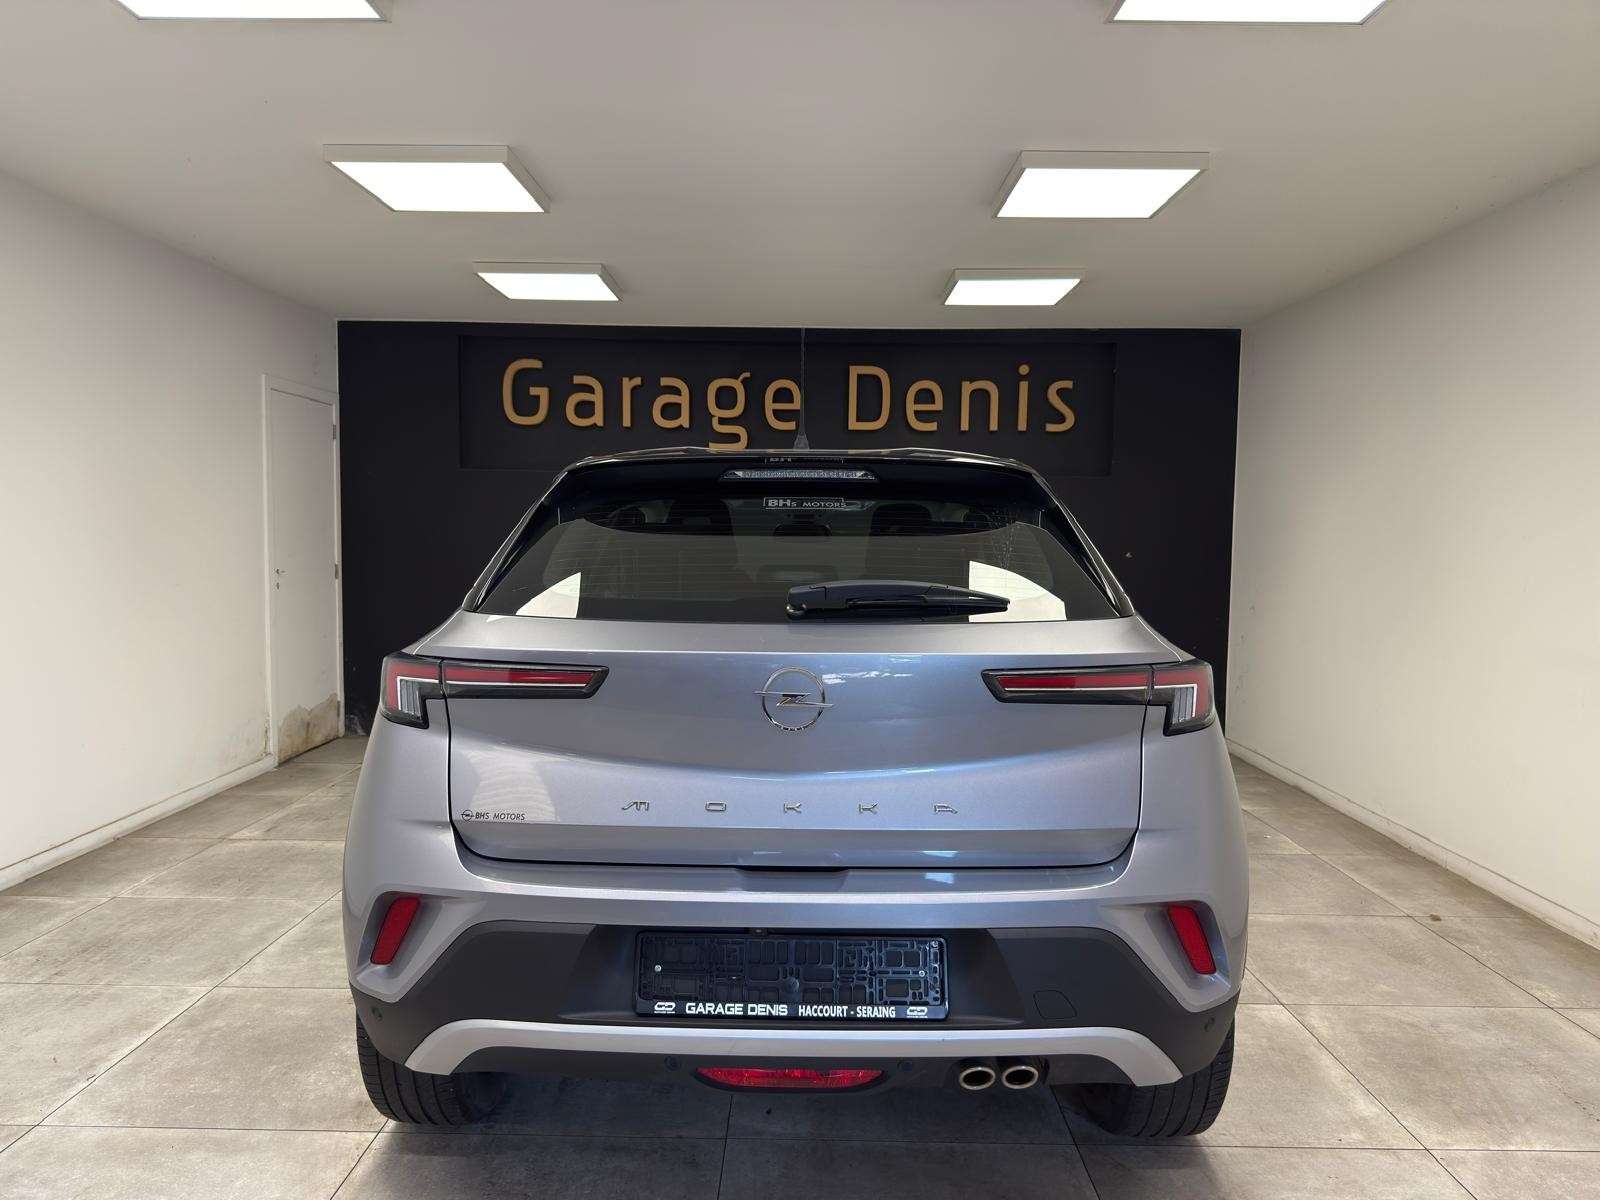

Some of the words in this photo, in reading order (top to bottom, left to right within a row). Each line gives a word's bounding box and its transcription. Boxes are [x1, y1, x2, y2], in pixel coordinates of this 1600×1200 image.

[502, 358, 801, 451] Garage
[847, 363, 1076, 433] Denis
[802, 501, 847, 509] MOTORS
[622, 800, 959, 815] MOKKA
[475, 812, 490, 820] BHS
[493, 812, 526, 821] MOTORS
[685, 1002, 744, 1015] GARAGE
[747, 1003, 788, 1016] DENIS
[798, 1005, 849, 1017] HACCOURT
[856, 1006, 896, 1019] SERAING
